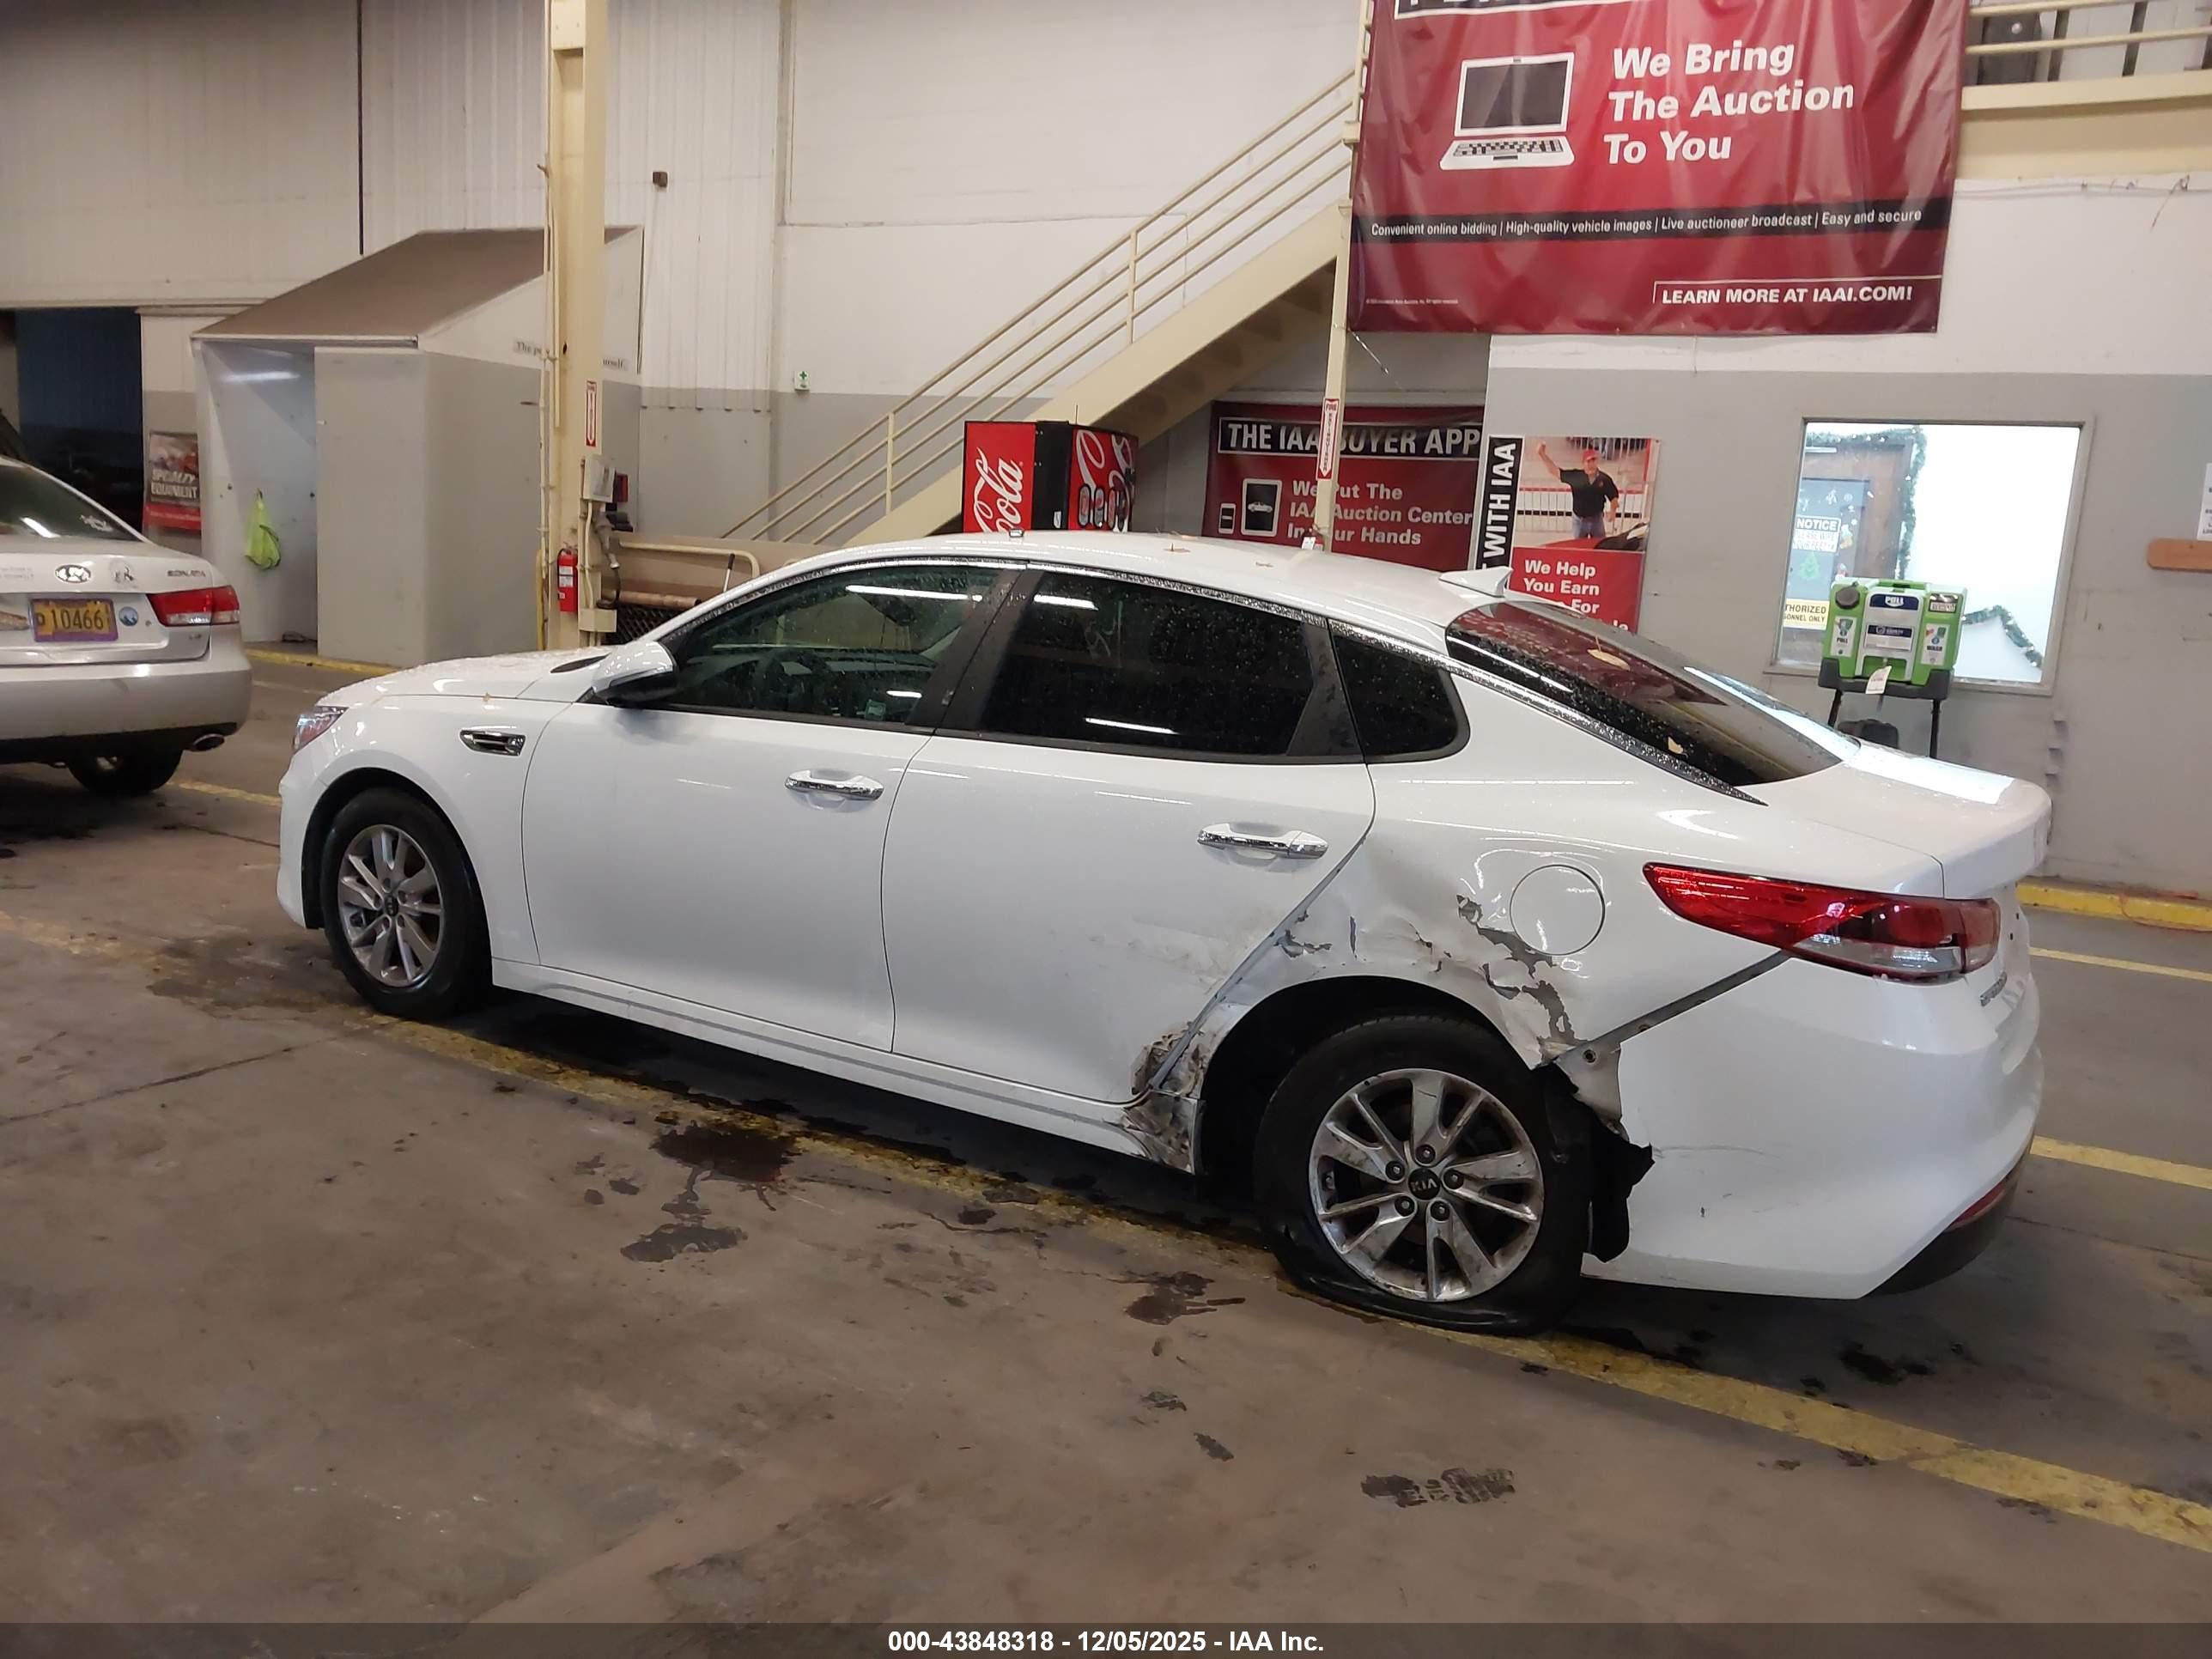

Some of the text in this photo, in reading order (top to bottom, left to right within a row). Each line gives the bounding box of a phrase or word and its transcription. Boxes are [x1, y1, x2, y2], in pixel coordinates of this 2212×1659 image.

[1613, 40, 1795, 80] We Bring
[1607, 79, 1854, 122] The Auction
[1603, 130, 1733, 165] To You
[1371, 222, 1425, 237] Convenient
[1427, 222, 1457, 235] online
[1461, 222, 1497, 237] bidding
[1505, 220, 1569, 236] High-quality
[1571, 219, 1611, 234] vehicle
[1613, 218, 1652, 233] images
[1662, 216, 1684, 230] Live
[1686, 215, 1749, 229] auctioneer
[1752, 212, 1813, 228] broadcast
[1822, 211, 1851, 227] Easy
[1853, 210, 1875, 224] and
[1878, 210, 1922, 223] secure
[1662, 285, 1912, 304] LEARN MORE AT IAAI.COM!
[1227, 422, 1273, 450] THE
[1279, 425, 1320, 452] IAA
[1424, 428, 1480, 455] APP
[1292, 479, 1403, 500] We ut The
[1484, 443, 1516, 559] WITH IAA
[1334, 503, 1403, 522] Auction
[1407, 507, 1472, 526] Center
[1796, 518, 1838, 532] NOTICE
[1288, 523, 1421, 545] In ur Hands
[1524, 559, 1596, 580] We Help
[1523, 577, 1600, 595] You Earn
[1571, 599, 1600, 614] For
[1786, 604, 1826, 614] THORIZED
[51, 608, 104, 630] 10466
[1809, 614, 1826, 623] ONLY
